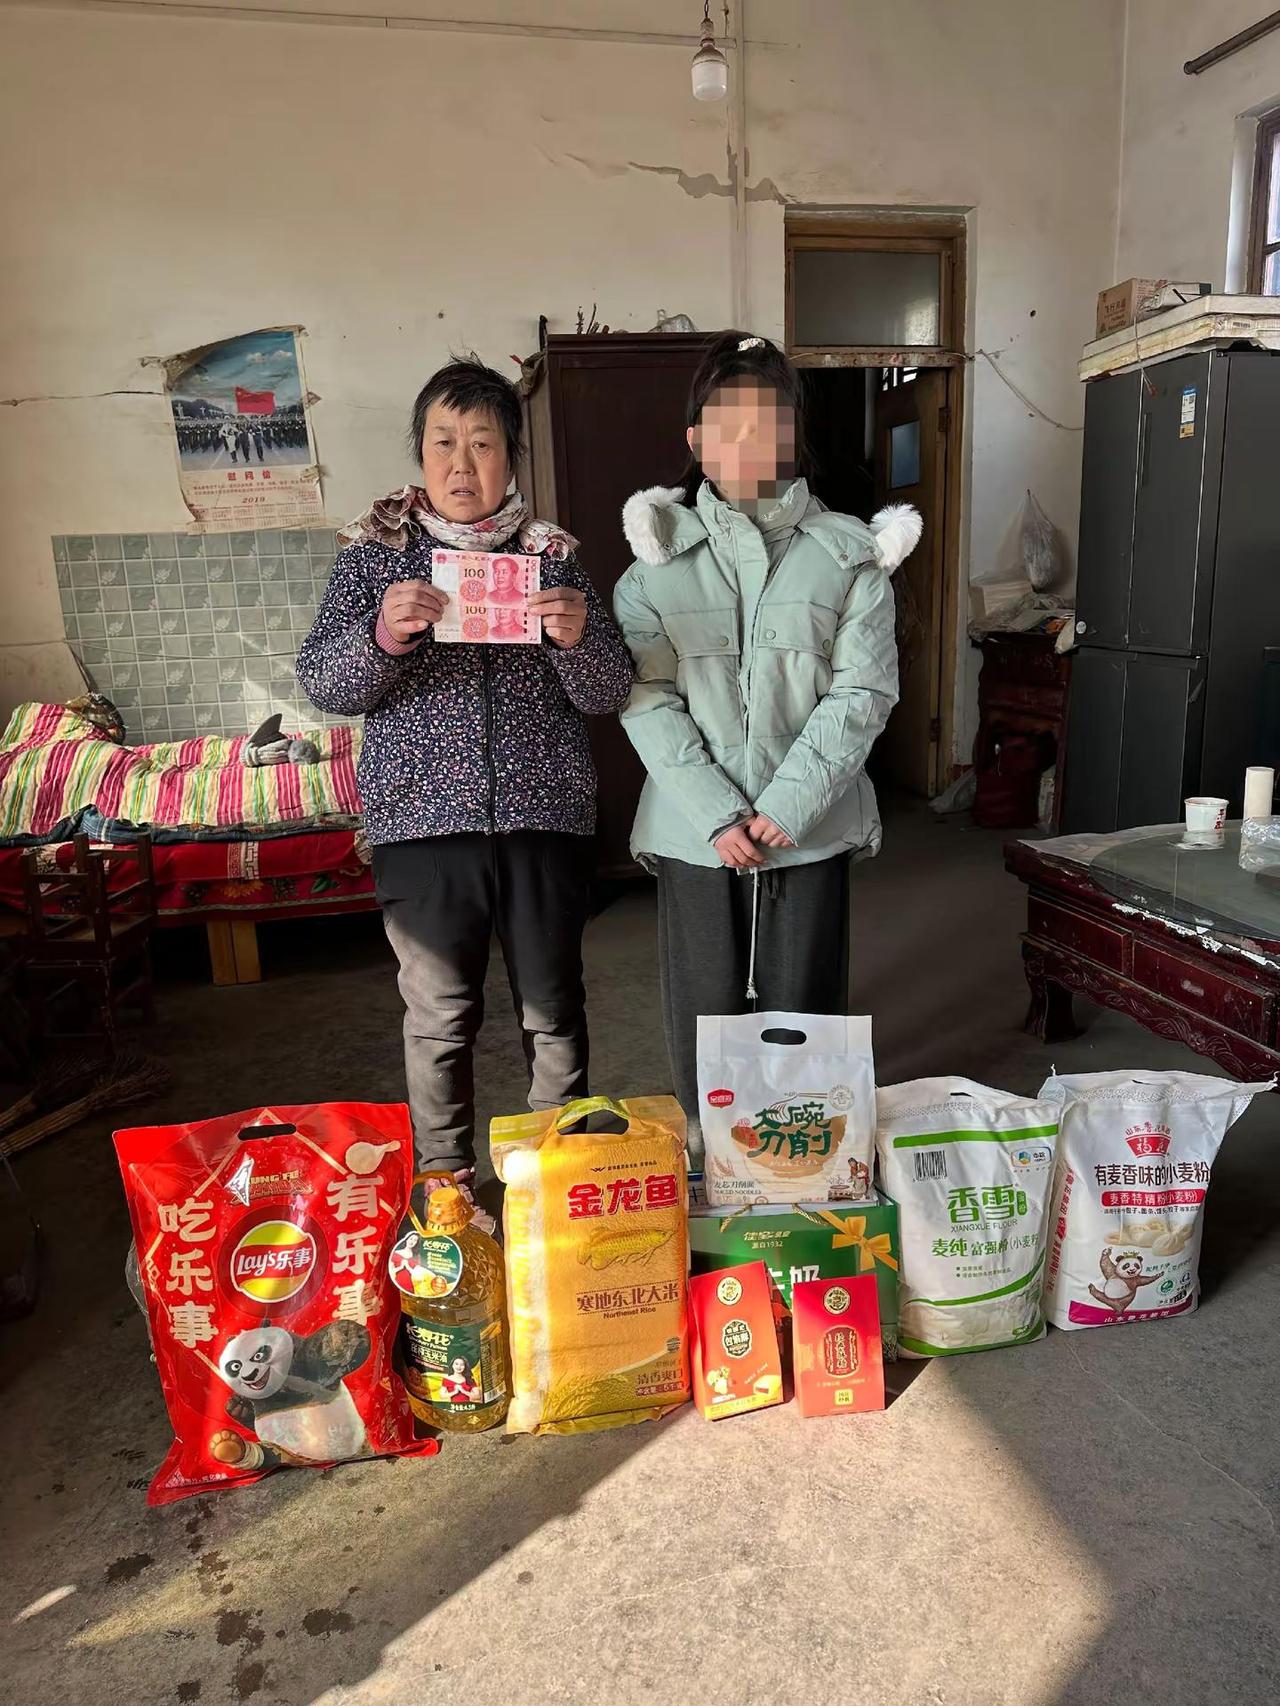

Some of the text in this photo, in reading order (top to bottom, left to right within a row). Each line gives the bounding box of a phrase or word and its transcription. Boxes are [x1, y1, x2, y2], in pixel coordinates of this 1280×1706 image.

[464, 568, 485, 579] 100
[465, 606, 486, 615] 100
[1094, 1162, 1210, 1187] 有麦香味的小麦粉
[567, 1174, 679, 1220] 金龙鱼
[947, 1184, 1015, 1224] 香雪
[326, 1174, 385, 1327] 有乐事
[931, 1238, 968, 1258] 麦纯
[157, 1197, 220, 1349] 吃乐事
[577, 1283, 679, 1312] 寒地东北大米
[603, 1306, 656, 1320] Northeast Rice
